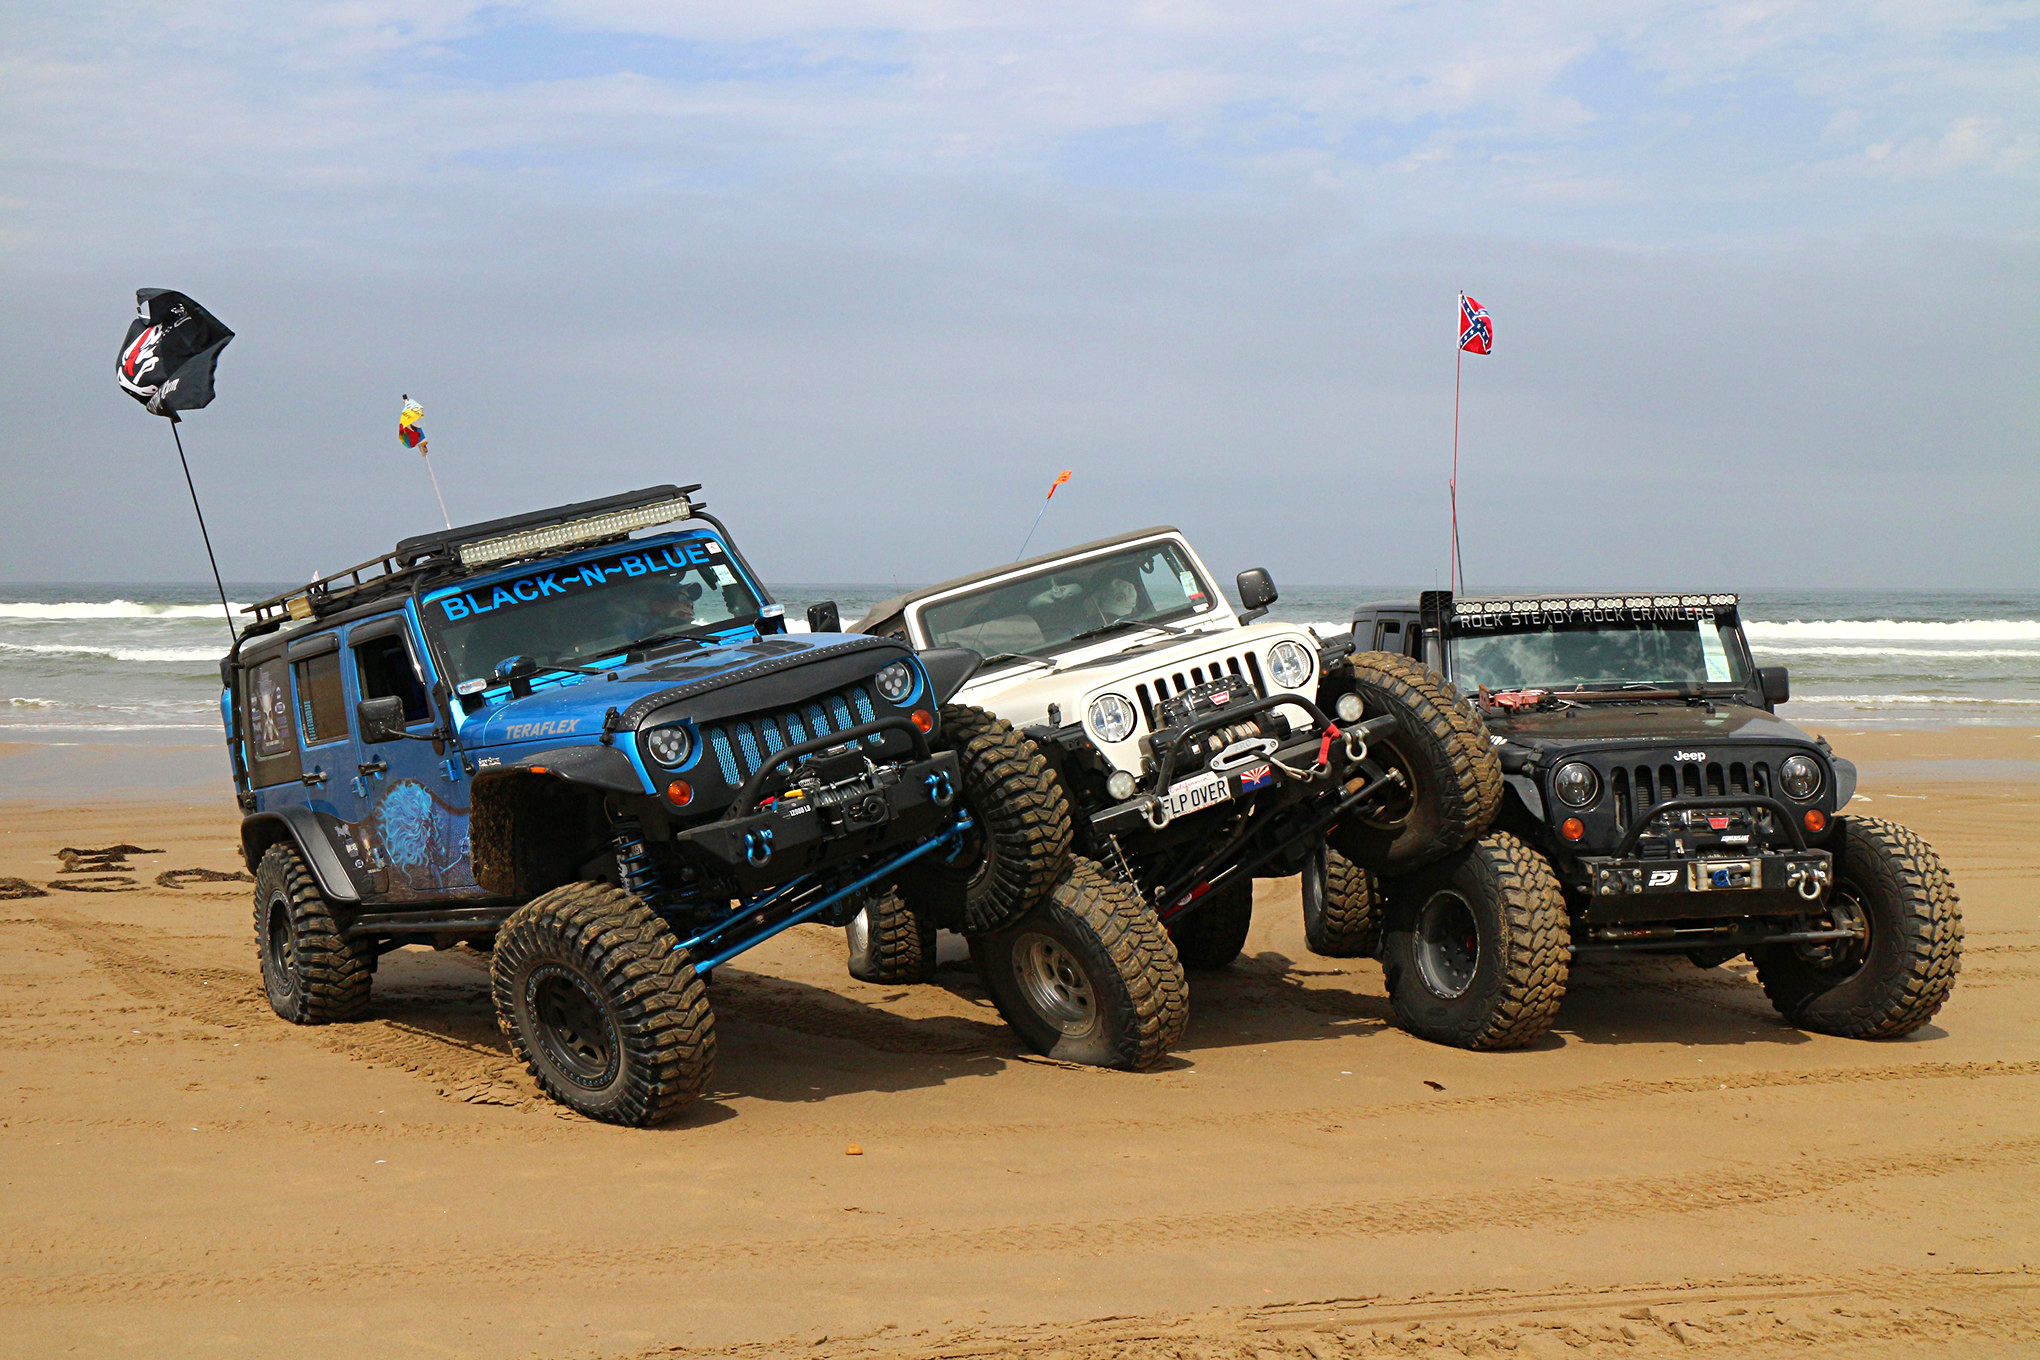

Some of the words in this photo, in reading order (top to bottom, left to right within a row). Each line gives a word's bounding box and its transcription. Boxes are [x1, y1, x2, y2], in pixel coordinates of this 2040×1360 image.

[1460, 613, 1504, 628] ROCK
[1510, 610, 1575, 626] STEADY
[1582, 608, 1625, 622] ROCK
[1631, 607, 1716, 621] CRAWLERS
[506, 718, 581, 740] TERAFLEX
[1673, 751, 1706, 762] Jeep
[1191, 780, 1228, 807] OVER
